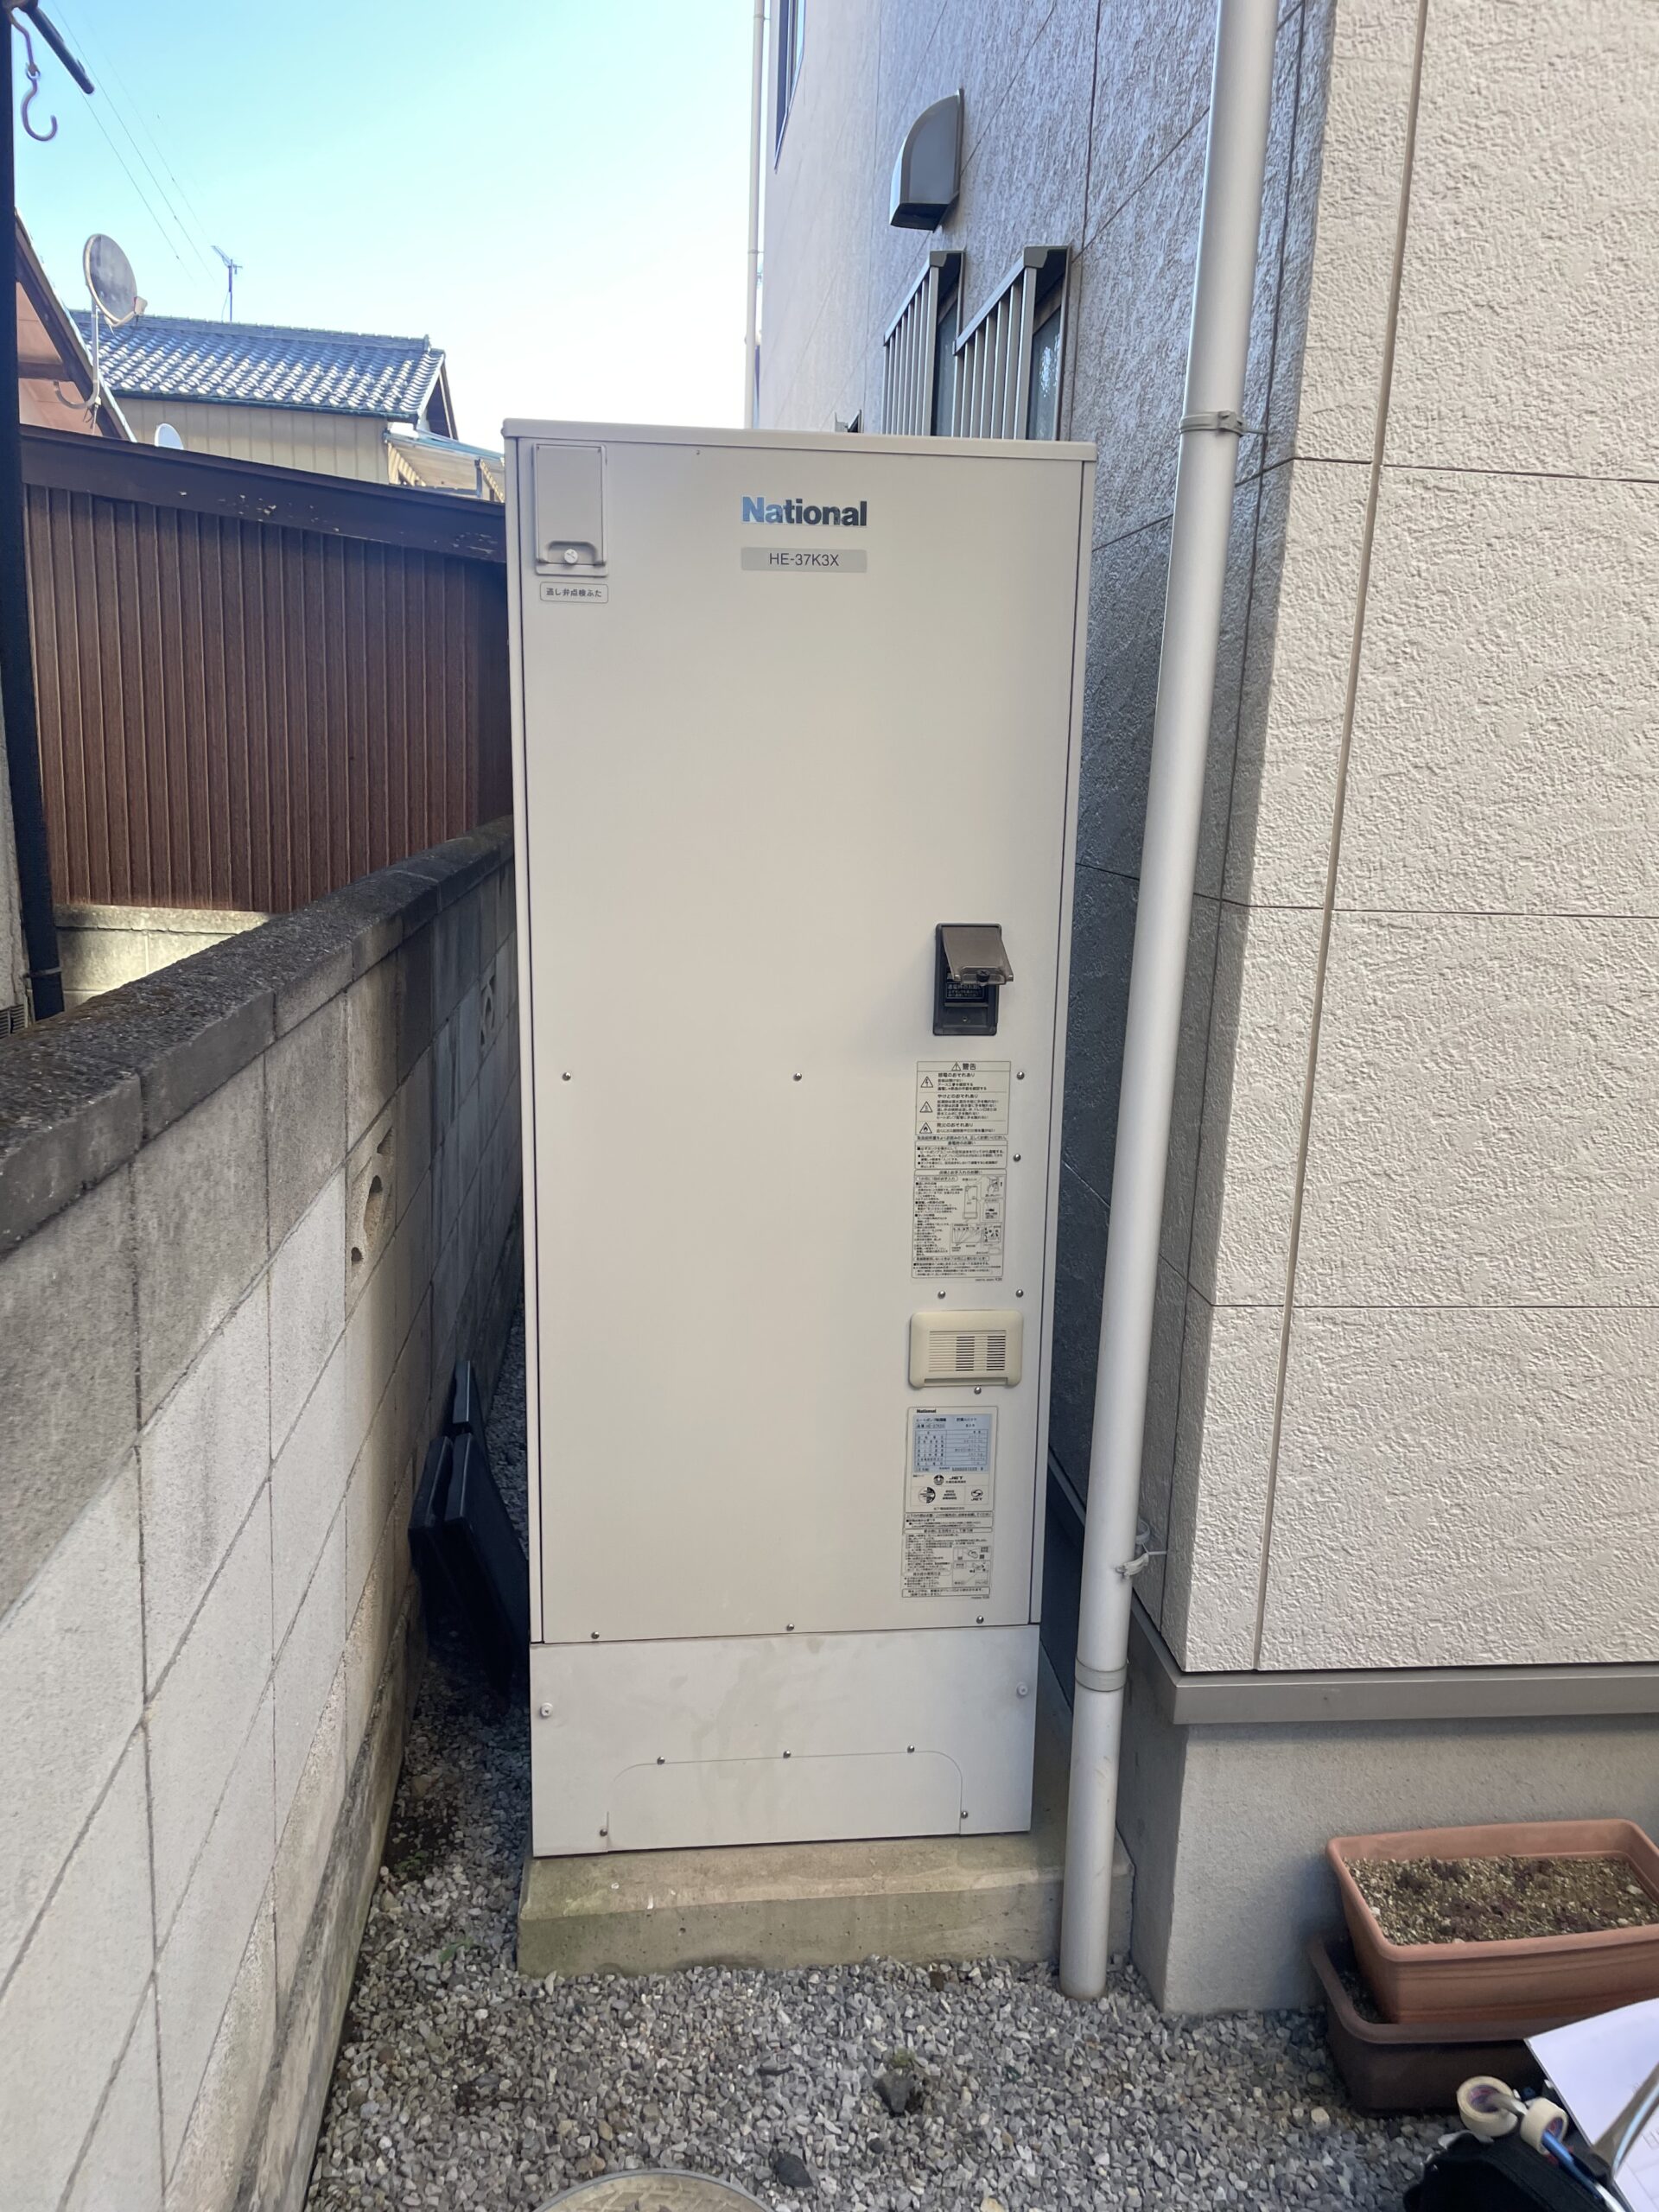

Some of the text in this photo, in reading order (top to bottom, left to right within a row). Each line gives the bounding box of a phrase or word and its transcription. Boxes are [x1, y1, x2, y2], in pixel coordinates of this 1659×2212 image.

[742, 496, 868, 526] National
[769, 552, 840, 567] HE-37K3X
[546, 588, 602, 598] 逃し弁点検ふた
